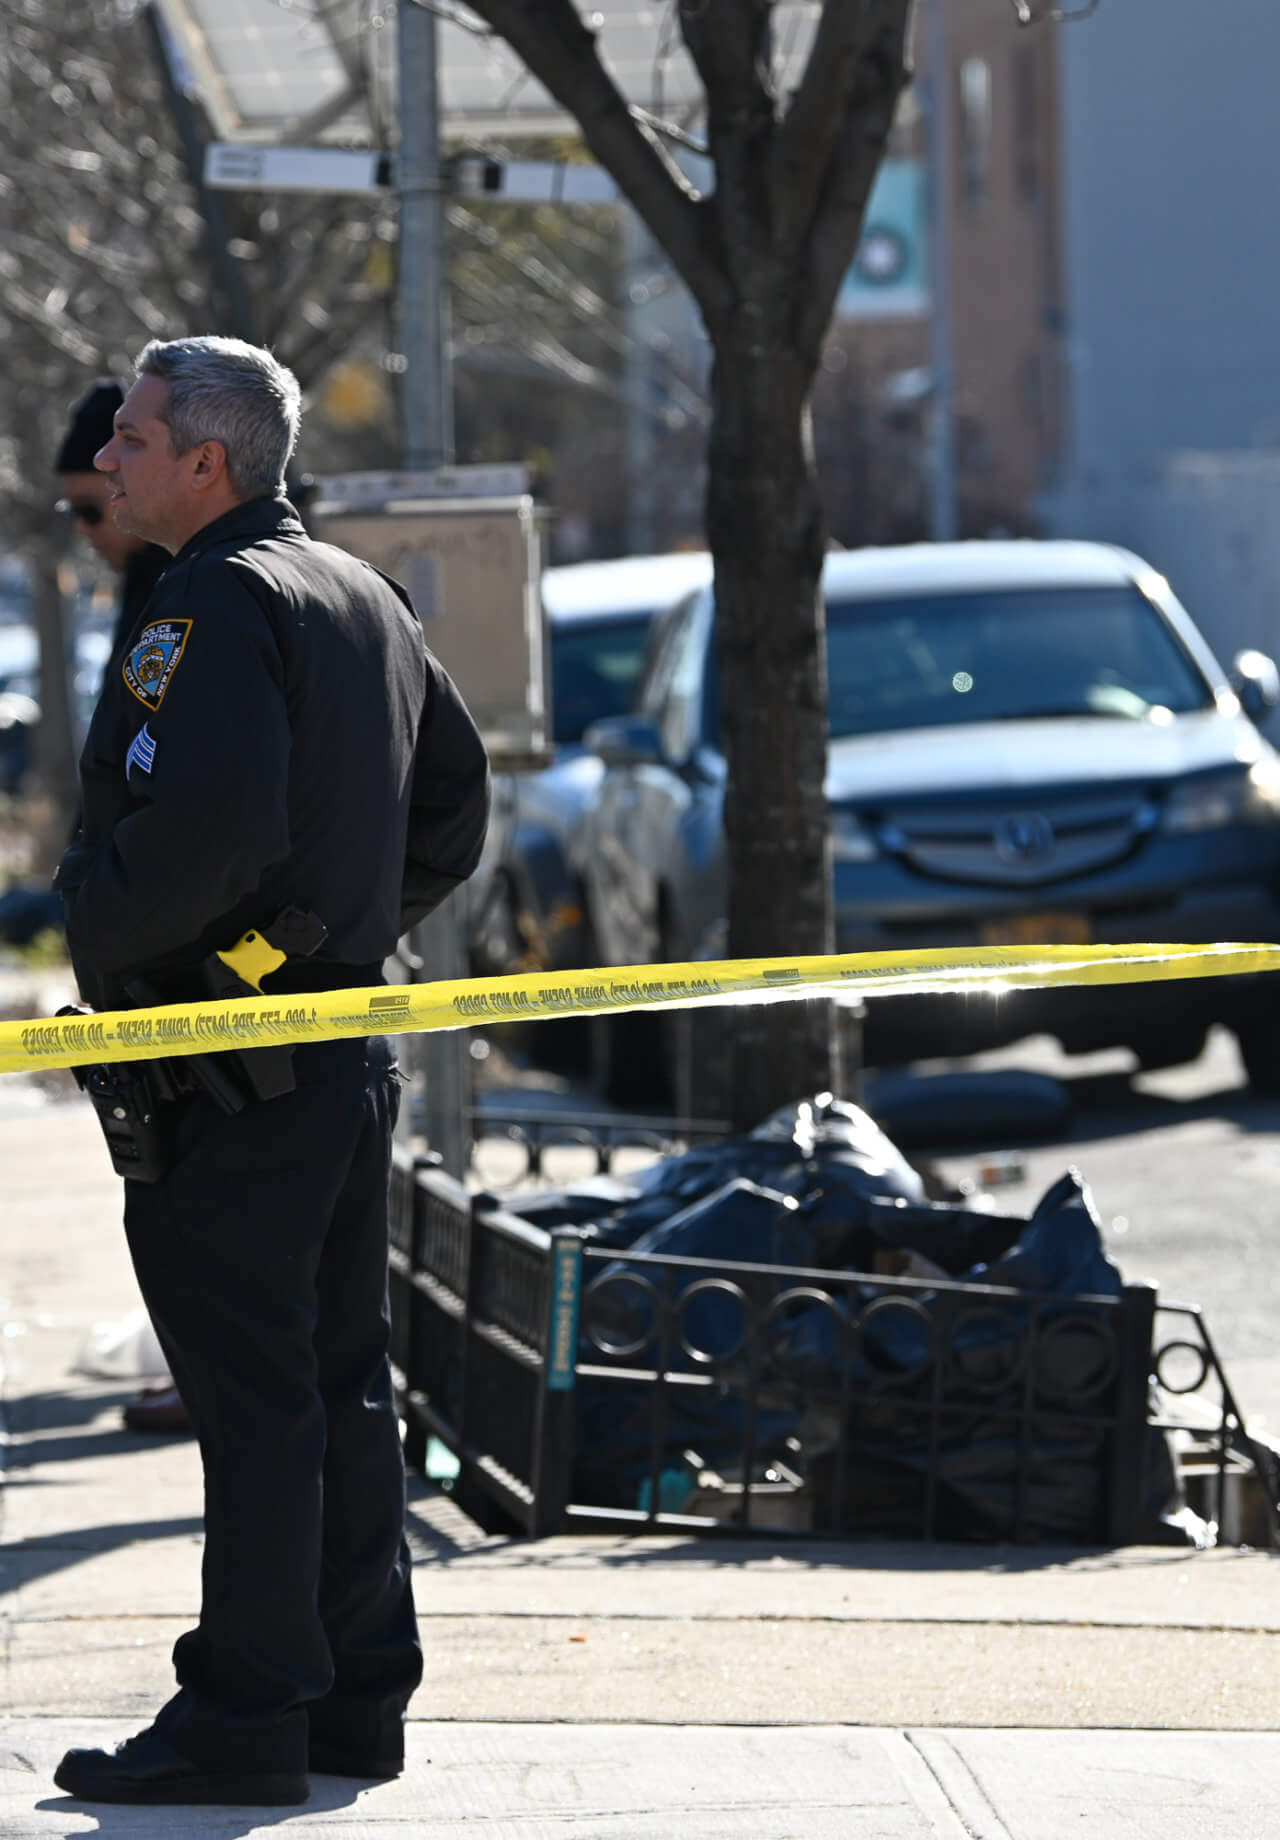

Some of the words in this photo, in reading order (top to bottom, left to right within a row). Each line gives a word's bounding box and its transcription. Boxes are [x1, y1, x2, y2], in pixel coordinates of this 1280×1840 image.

[141, 624, 172, 640] POLICE
[125, 666, 138, 687] CITY
[136, 686, 149, 699] OF
[157, 674, 168, 697] NEW
[165, 646, 182, 673] YORK
